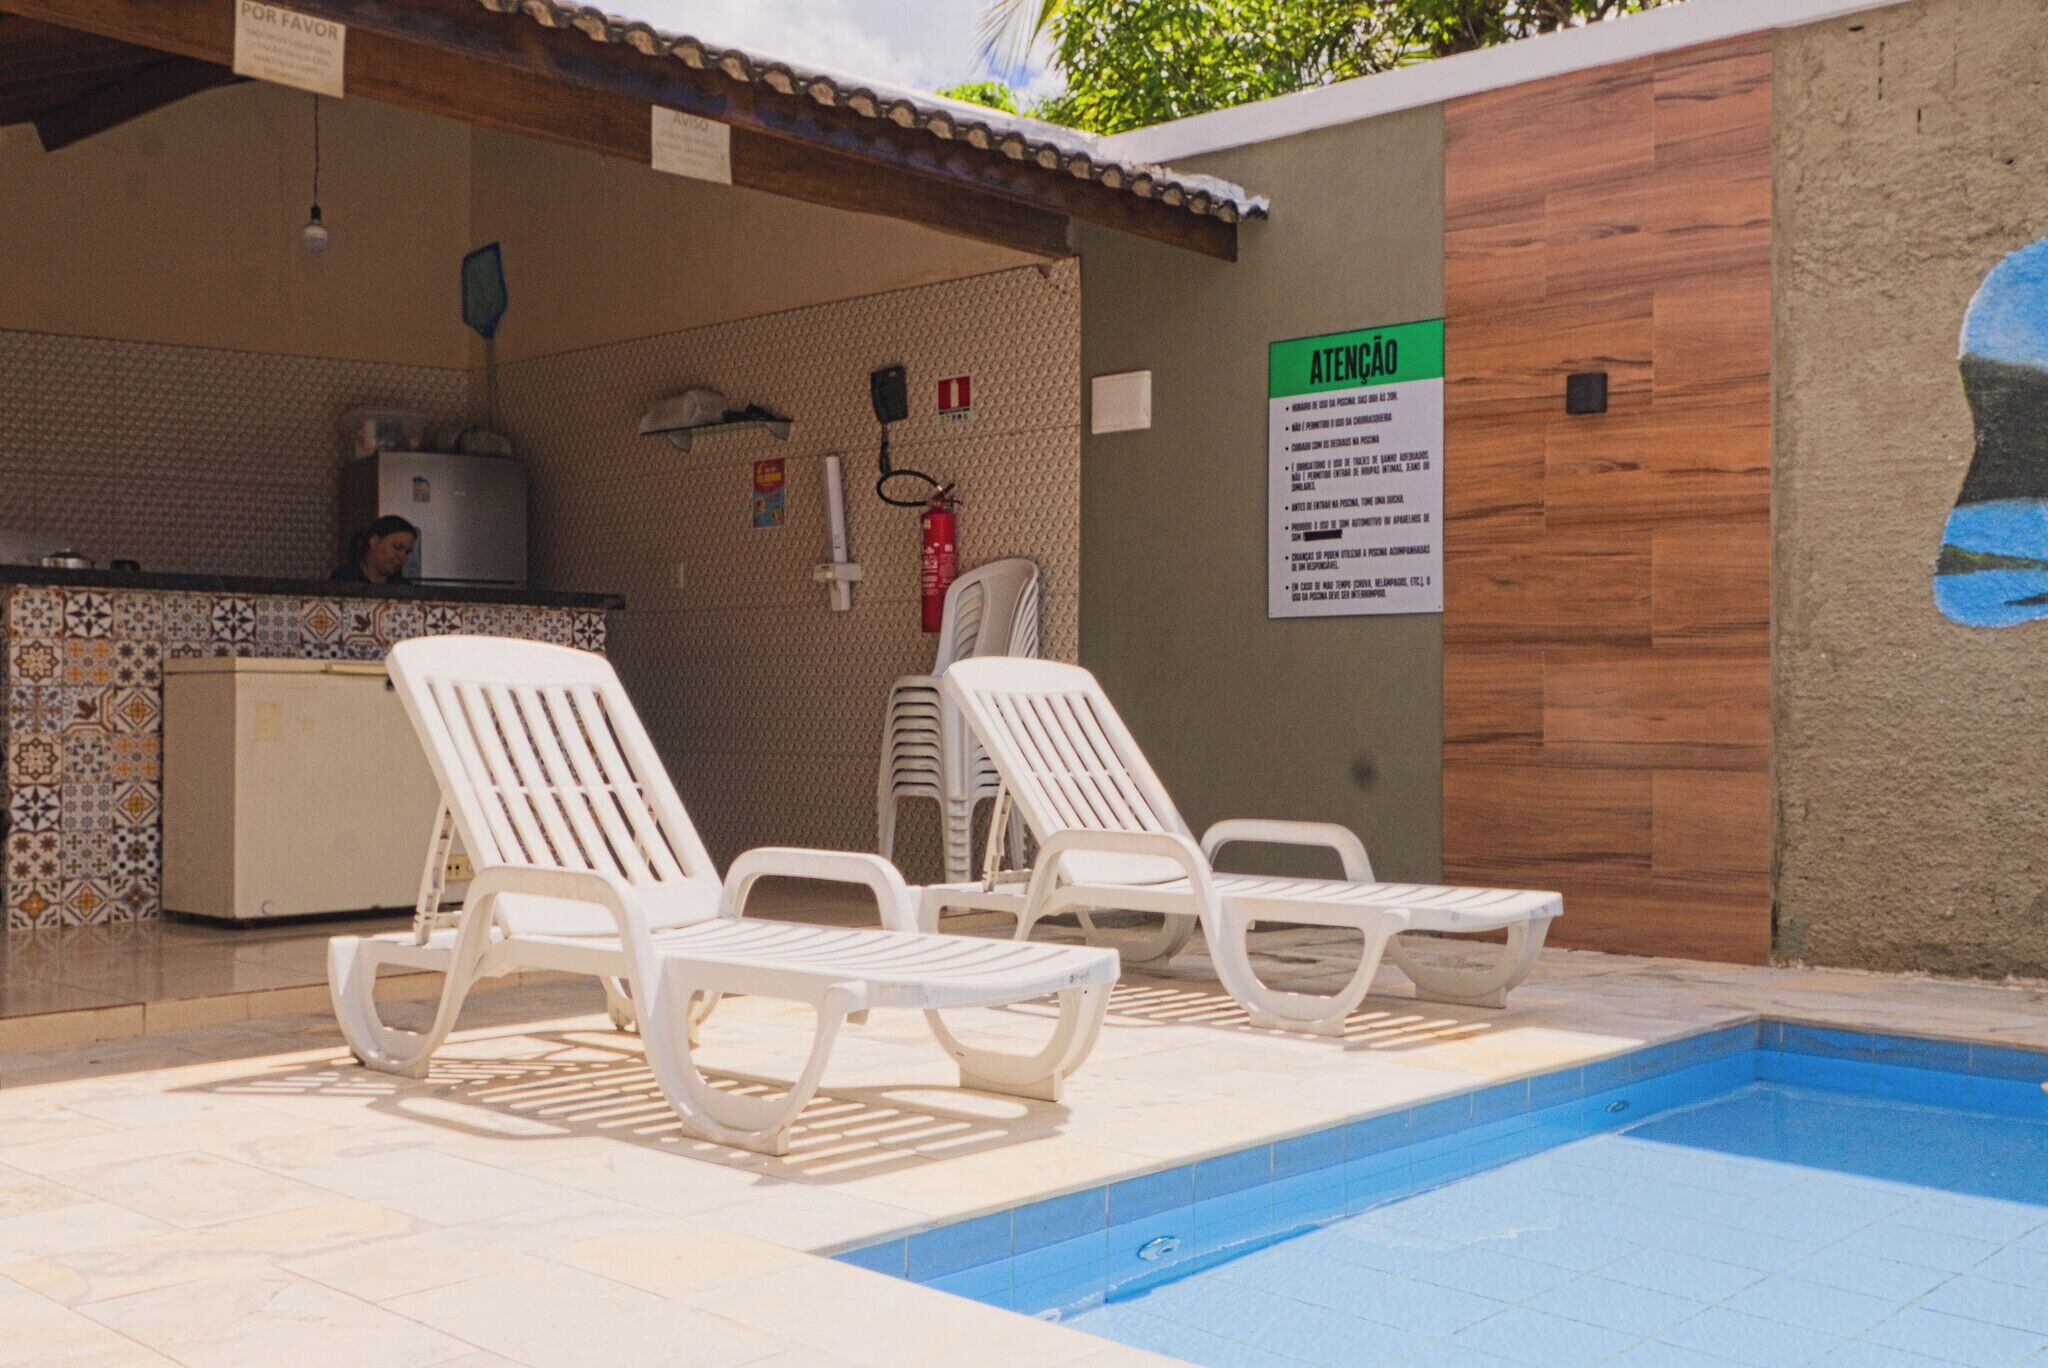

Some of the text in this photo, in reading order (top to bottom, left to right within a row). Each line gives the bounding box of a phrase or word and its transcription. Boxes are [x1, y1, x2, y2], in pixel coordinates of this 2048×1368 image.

[241, 2, 338, 40] POR FAVOR
[1310, 335, 1398, 384] ATENÇÃO
[1312, 400, 1317, 410] DE
[1306, 419, 1329, 431] PERMITIDO
[1353, 413, 1392, 425] CHURRASQUEIRA
[1312, 440, 1322, 450] COM
[1352, 436, 1359, 446] NA
[1360, 434, 1380, 445] PISCINA
[1353, 455, 1370, 466] TRAJES
[1371, 454, 1378, 464] DE
[1380, 453, 1397, 464] BANHO
[1307, 469, 1331, 480] PERMITIDO
[1333, 467, 1351, 478] ENTRAR
[1352, 466, 1359, 477] DE
[1361, 465, 1380, 476] ROUPAS
[1405, 461, 1421, 472] JEANS
[1291, 501, 1306, 512] ANTES
[1306, 500, 1312, 511] DE
[1313, 499, 1331, 510] ENTRAR
[1332, 498, 1339, 509] NA
[1351, 516, 1382, 528] AUTOMOTIVO
[1393, 513, 1422, 525] APARELHOS
[1423, 512, 1430, 523] DE
[1291, 551, 1315, 562] CRIANÇAS
[1323, 549, 1340, 560] PODEM
[1340, 548, 1362, 559] UTILIZAR
[1368, 547, 1387, 557] PISCINA
[1389, 544, 1431, 556] ACOMPANHADAS
[1291, 581, 1298, 592] EM
[1335, 579, 1351, 590] TEMPO
[1309, 591, 1328, 601] PISCINA
[1328, 590, 1340, 600] DEVE
